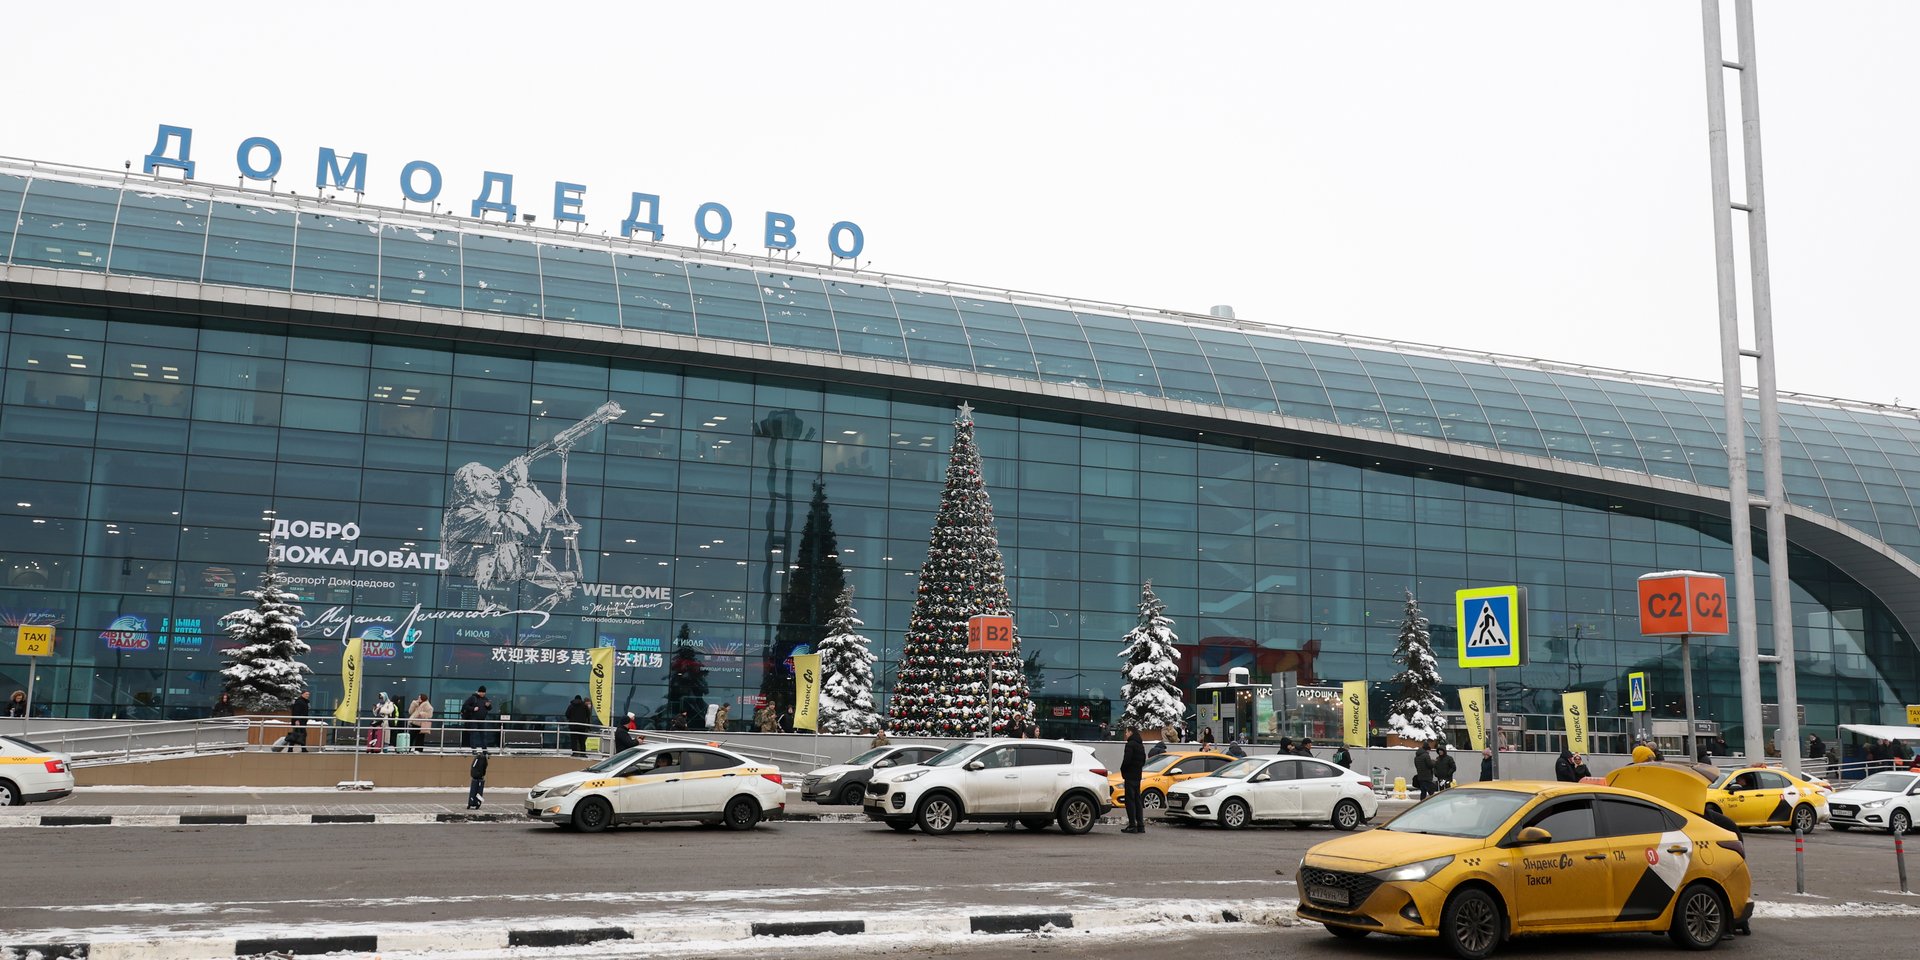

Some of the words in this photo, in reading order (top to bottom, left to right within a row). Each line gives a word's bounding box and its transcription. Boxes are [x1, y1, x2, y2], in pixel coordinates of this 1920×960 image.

[143, 124, 865, 260] ДОМОДЕДОВО
[271, 519, 361, 541] ДОБРО
[328, 576, 395, 588] Домодедово
[582, 583, 671, 600] WELCOME
[1648, 591, 1683, 619] C2
[1695, 591, 1723, 618] C2
[300, 604, 394, 647] Михаила
[383, 602, 550, 649] Ломоносова
[581, 616, 623, 624] Domodedovo
[623, 617, 646, 625] Airport
[23, 632, 47, 642] TAXI
[456, 629, 462, 637] 4
[464, 630, 490, 638] ИЮЛЯ
[987, 625, 1009, 641] B2
[27, 644, 39, 652] A2
[108, 638, 150, 649] РАДИО
[673, 638, 679, 646] 4
[492, 647, 663, 668] 欢迎来到多莫沃机场
[803, 669, 814, 684] Go
[1256, 687, 1273, 696] КРО
[801, 685, 812, 716] Яндекс
[1351, 706, 1360, 735] Яндекс
[1574, 716, 1583, 743] Яндекс
[1523, 858, 1559, 870] Яндекс
[1559, 853, 1574, 870] Go
[1612, 850, 1626, 862] 174
[1647, 850, 1656, 862] Я
[1526, 875, 1552, 886] Такси
